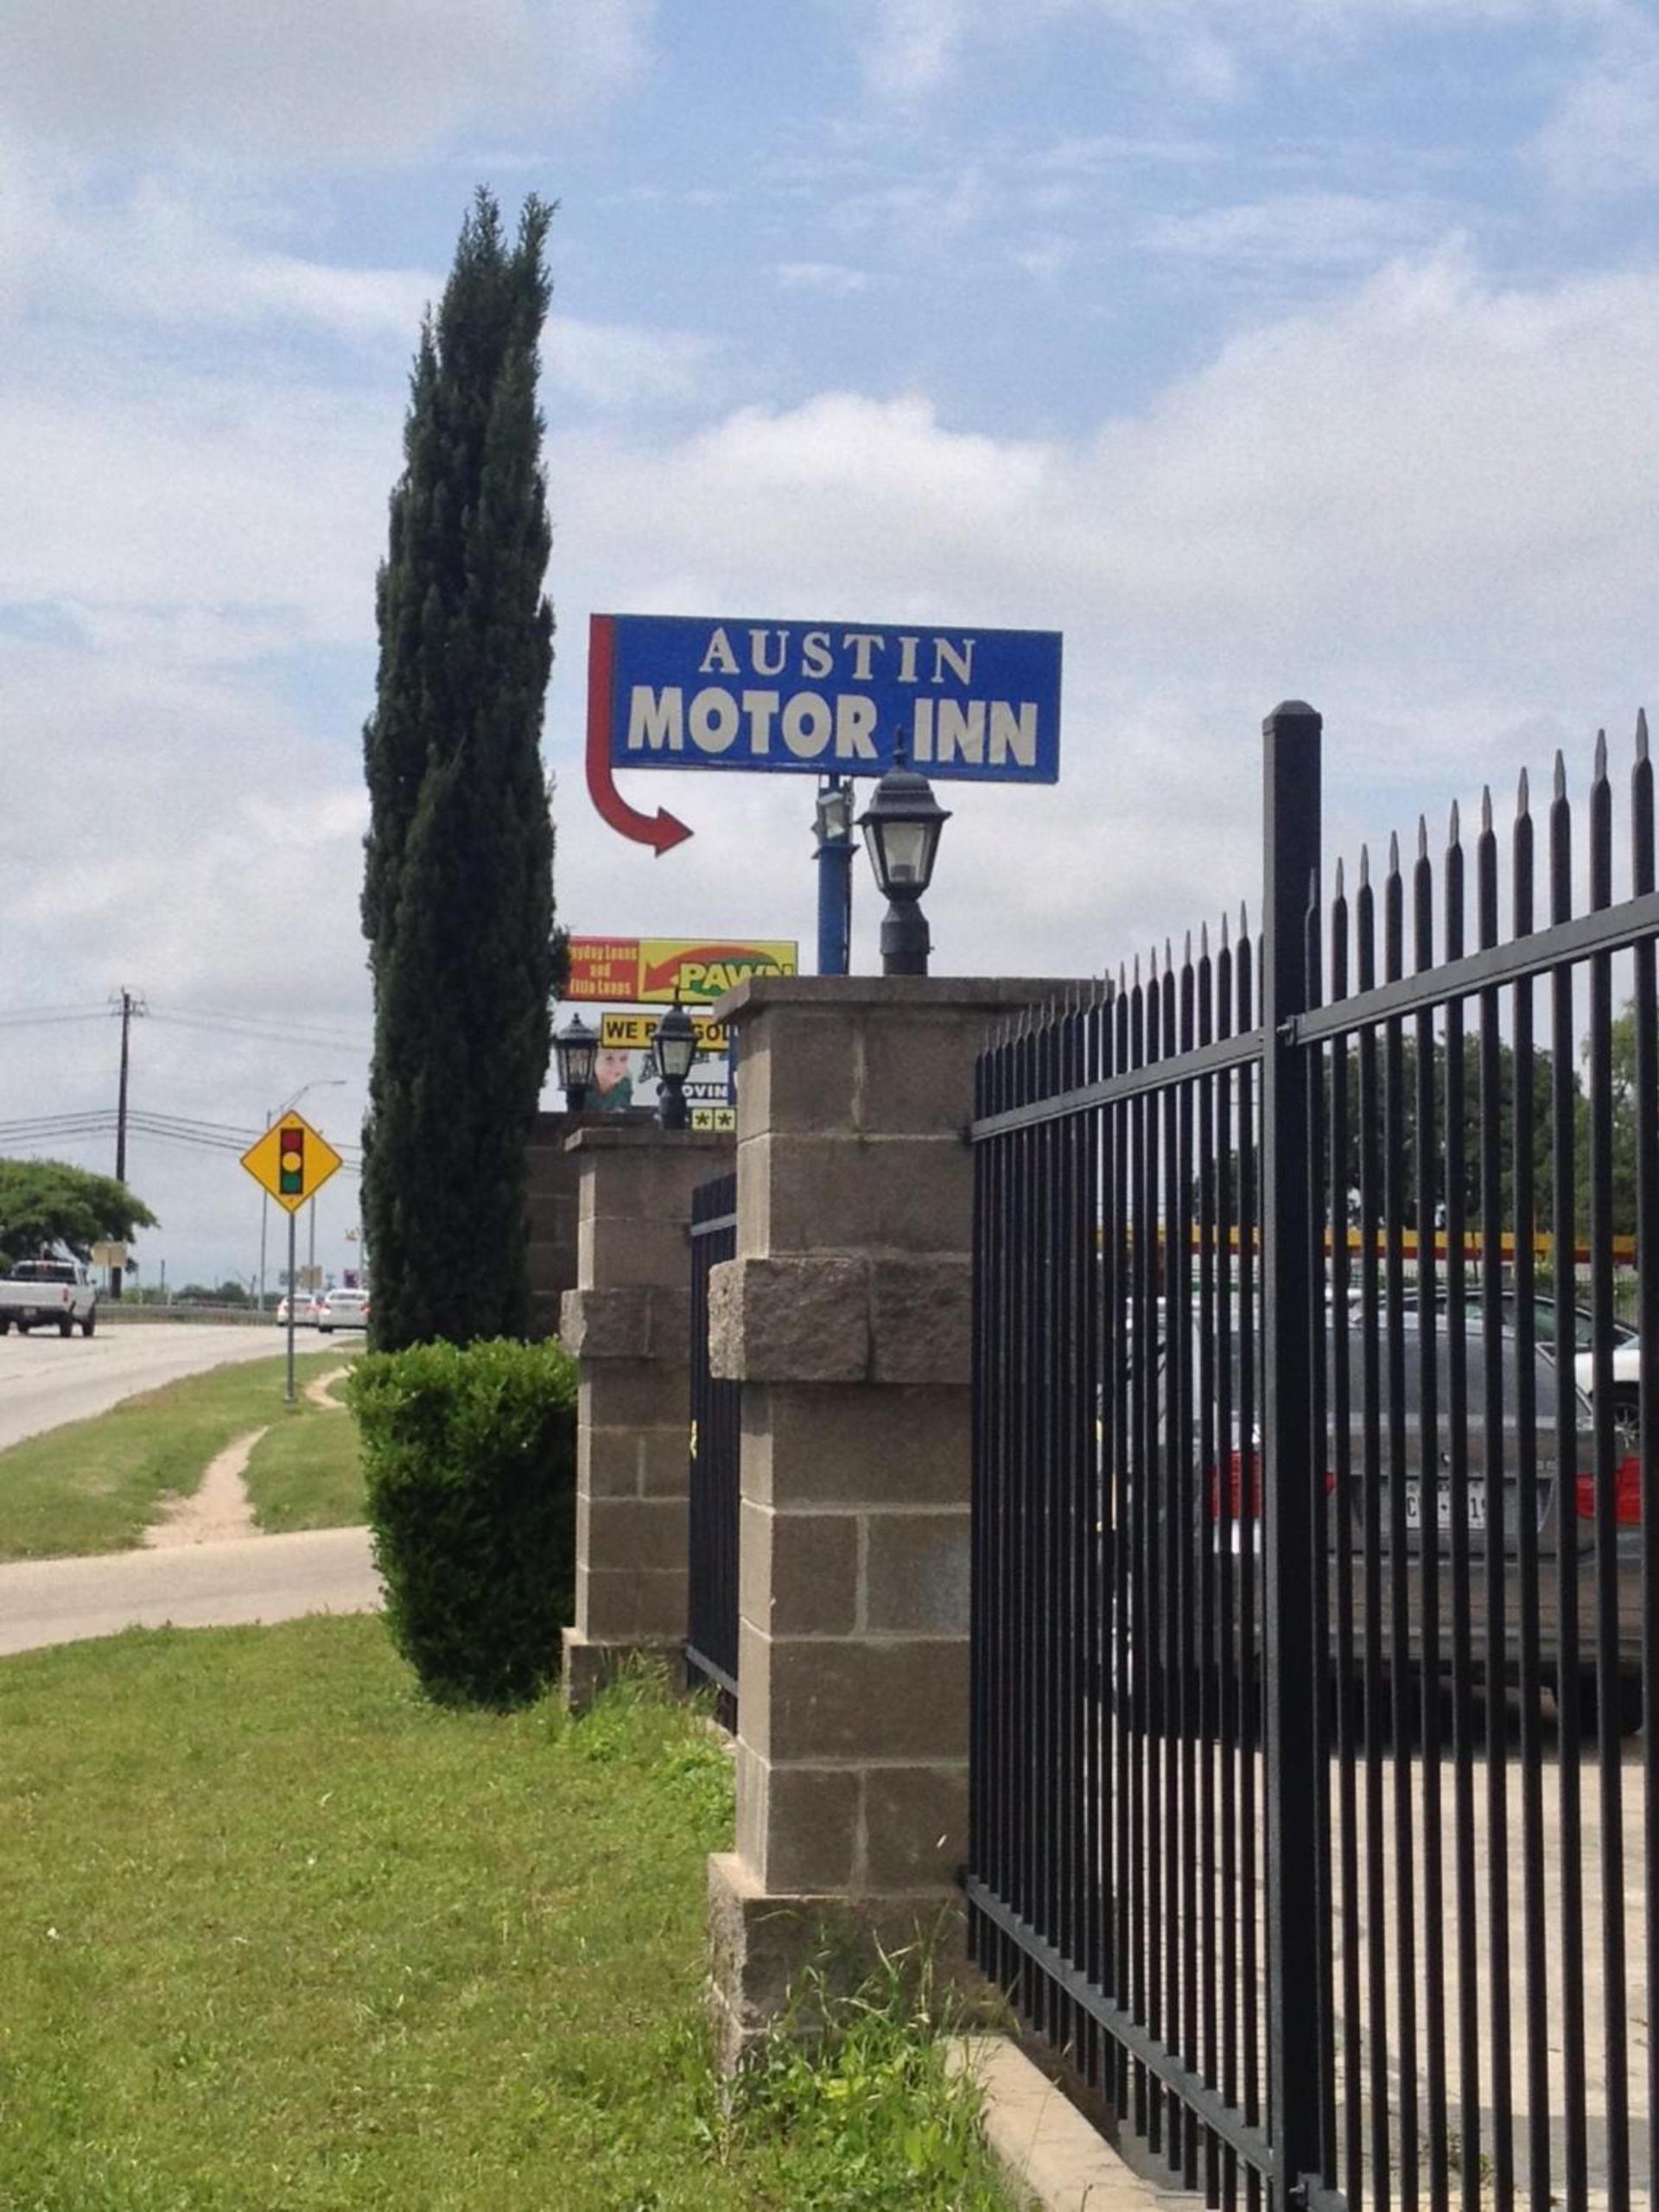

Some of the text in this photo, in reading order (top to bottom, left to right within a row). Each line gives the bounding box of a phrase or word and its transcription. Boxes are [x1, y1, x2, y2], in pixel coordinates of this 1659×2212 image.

[698, 627, 976, 685] AUSTIN
[628, 685, 1038, 766] MOTOR INN
[607, 1021, 638, 1039] WE
